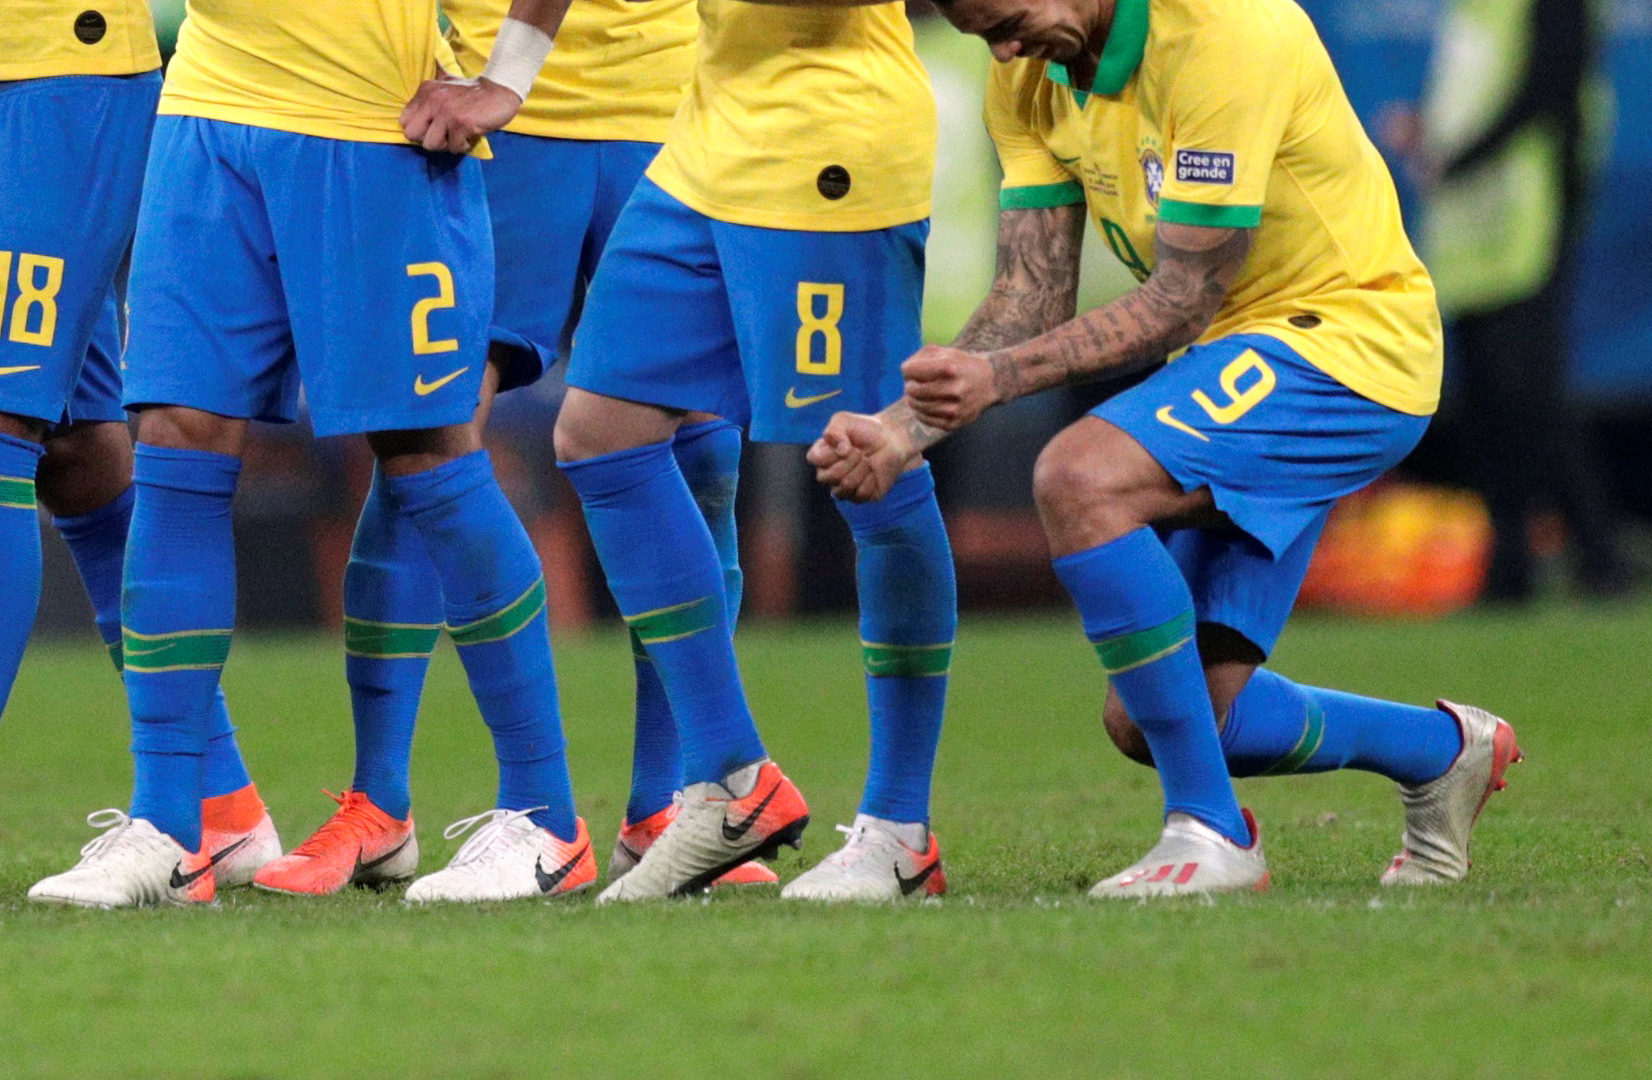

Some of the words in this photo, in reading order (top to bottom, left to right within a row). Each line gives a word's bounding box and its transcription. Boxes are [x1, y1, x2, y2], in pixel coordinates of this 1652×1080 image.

[1178, 152, 1210, 167] Cree
[1212, 157, 1231, 168] en
[1178, 165, 1227, 180] grande
[406, 261, 459, 356] 2
[795, 281, 845, 375] 8
[1190, 347, 1277, 425] 9
